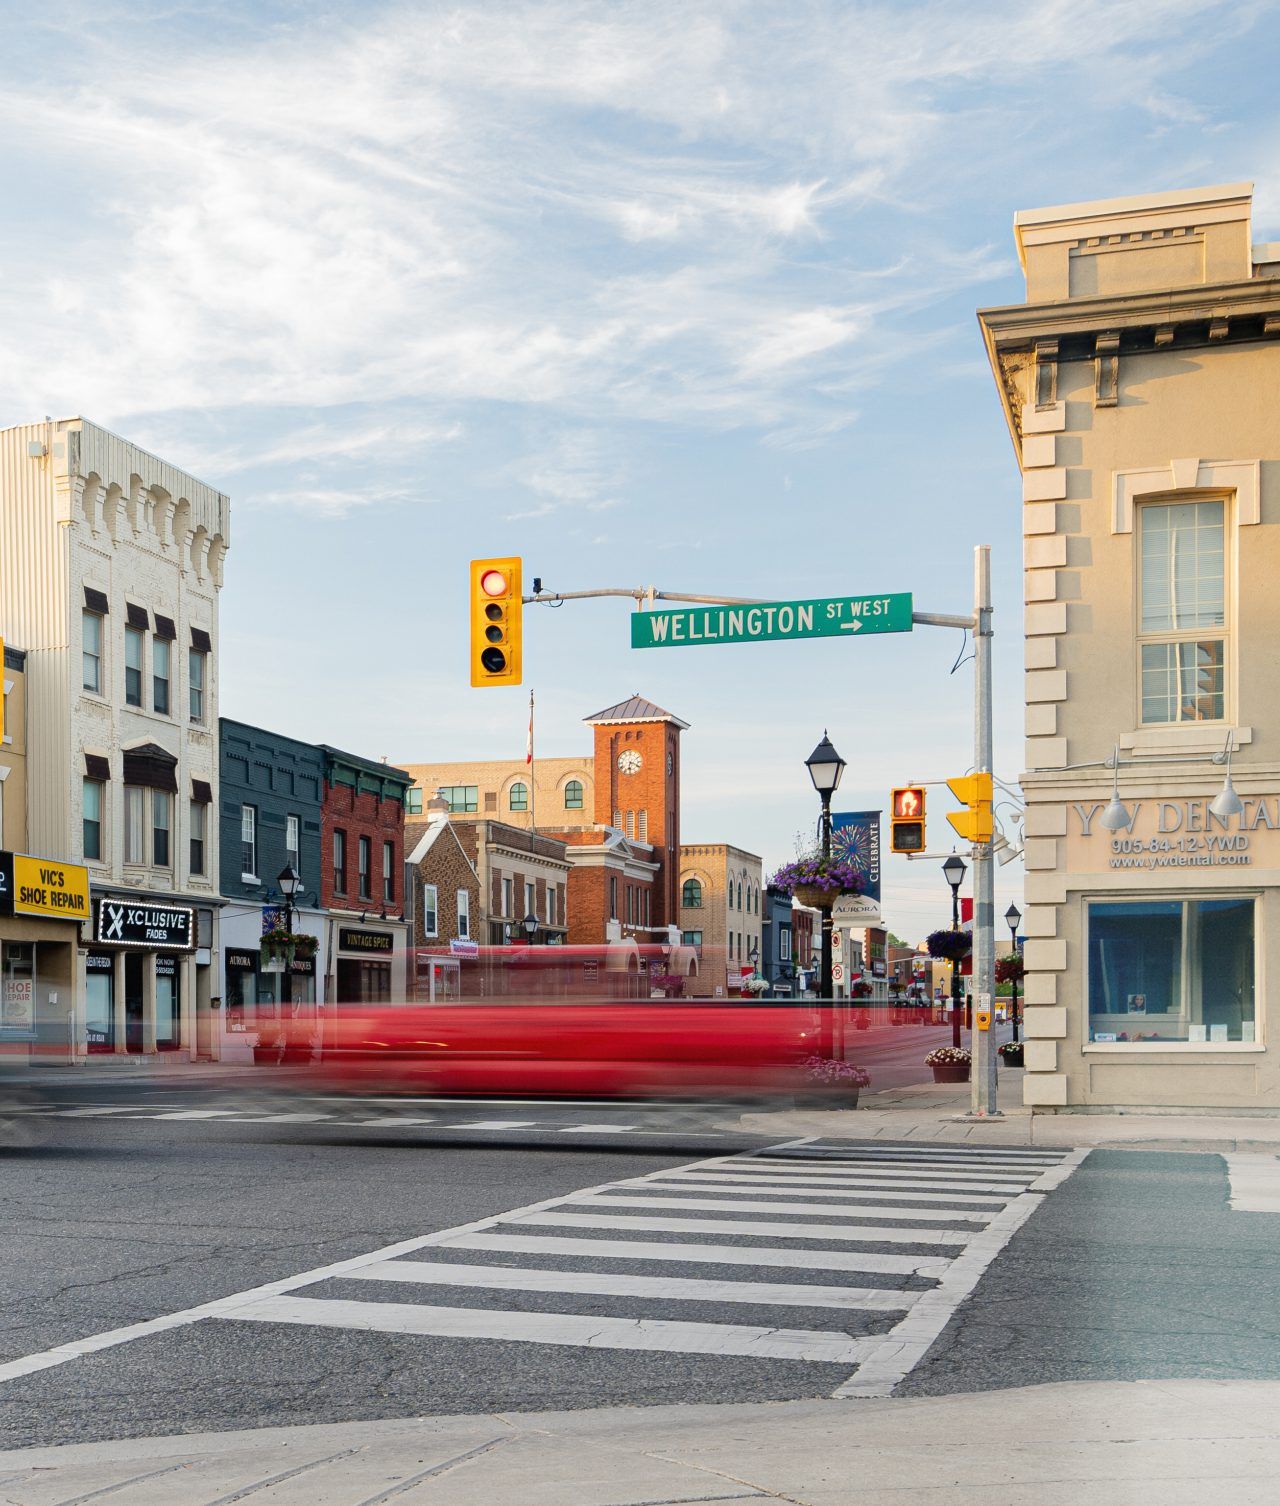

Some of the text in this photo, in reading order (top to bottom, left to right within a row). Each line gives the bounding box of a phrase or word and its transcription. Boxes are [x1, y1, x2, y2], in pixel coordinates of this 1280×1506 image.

[650, 599, 891, 642] WELLINGTON ST WEST
[1157, 799, 1280, 833] DENTA
[869, 822, 879, 883] CELEBRATE
[1111, 835, 1250, 855] 905-84-12-YWD
[1109, 853, 1252, 870] www.ywdental.com
[39, 868, 64, 887] VIC'S
[20, 886, 84, 910] SHOE REPAIR
[835, 905, 878, 913] AURORA
[126, 909, 185, 929] XCLUSIVE
[146, 929, 168, 940] FADES
[347, 933, 390, 949] VINTAGE SPICE
[229, 955, 251, 967] AURORA
[291, 961, 312, 972] ANTIQUES
[6, 982, 32, 993] HOE
[7, 993, 31, 1001] EPAIR
